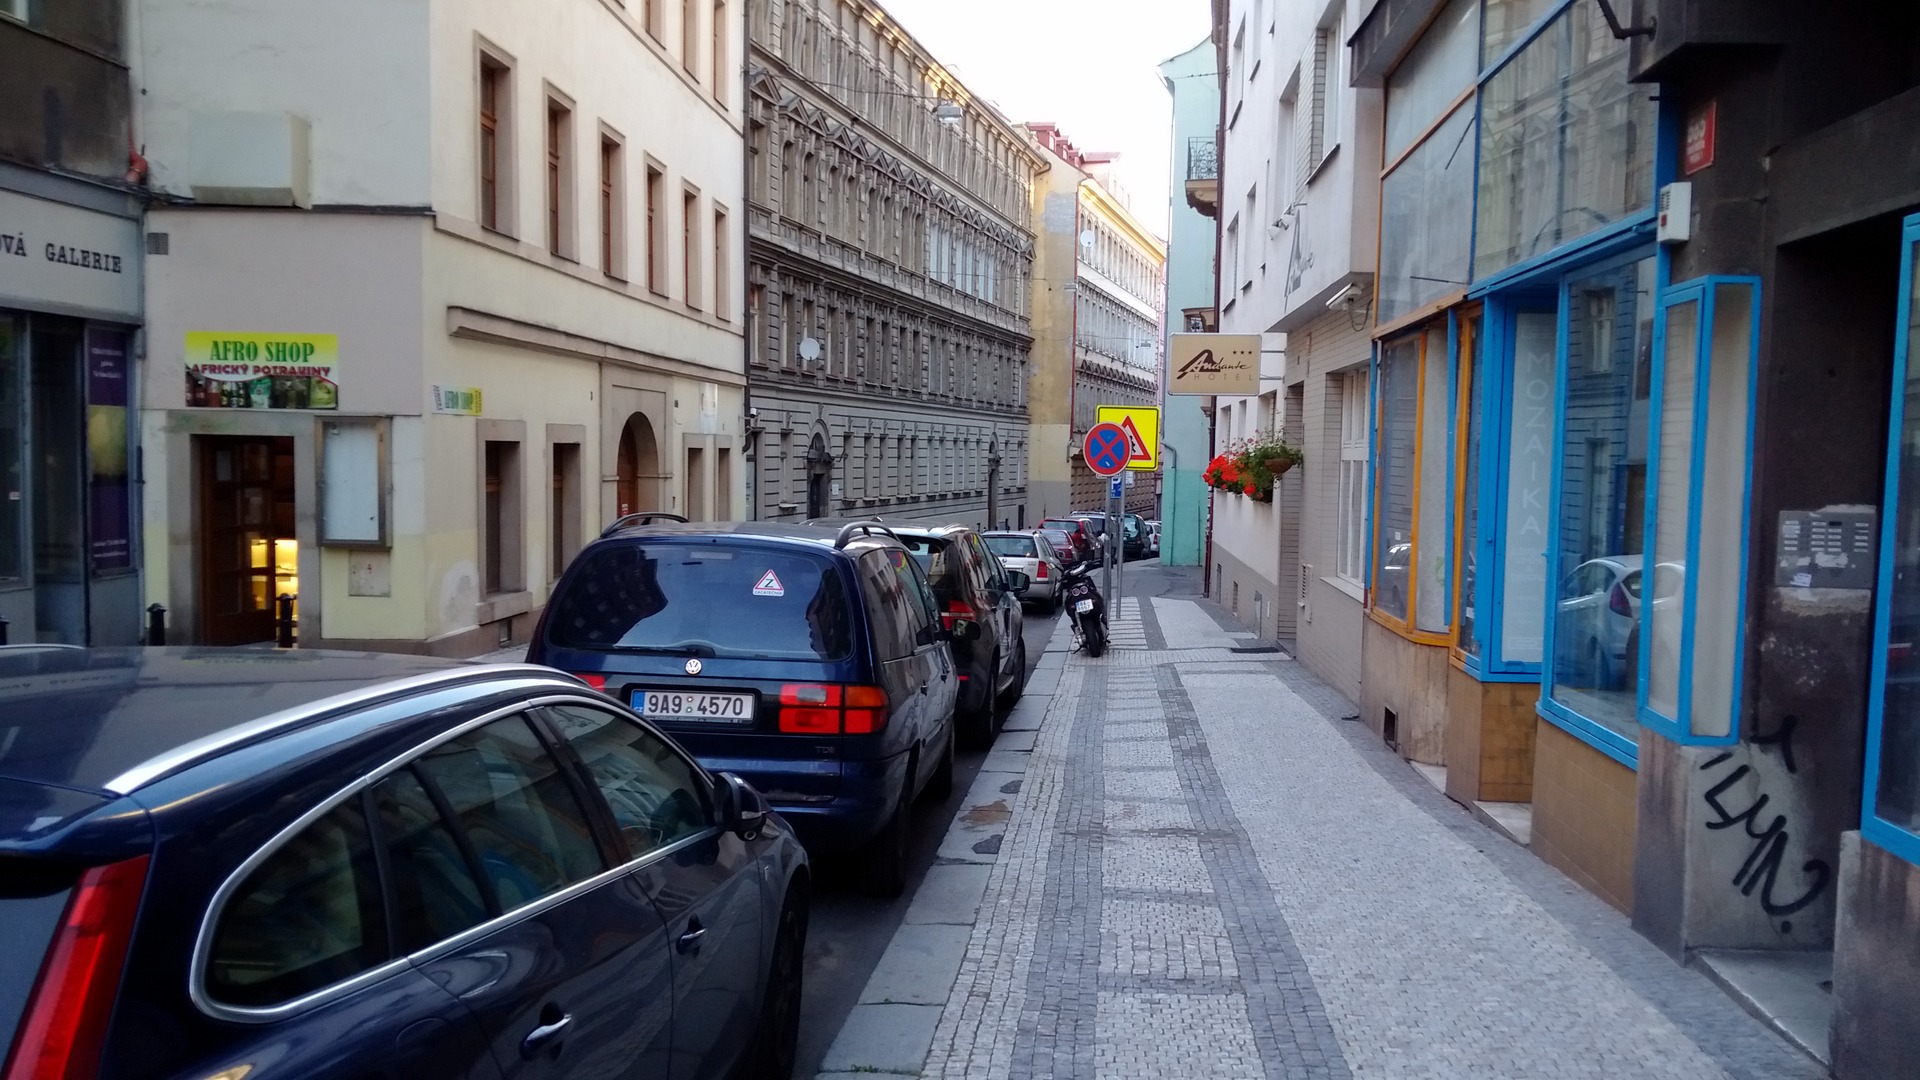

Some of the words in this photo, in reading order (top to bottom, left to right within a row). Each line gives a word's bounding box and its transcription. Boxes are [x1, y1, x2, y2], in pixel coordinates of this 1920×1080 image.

[0, 232, 27, 257] VÁ
[45, 242, 122, 274] GALERIE
[210, 340, 258, 362] AFRO
[265, 341, 315, 363] SHOP
[252, 365, 331, 377] POTRAVINY
[1176, 349, 1252, 380] Andante
[1194, 373, 1253, 381] HOTEL
[1520, 352, 1550, 536] MOZAIKA
[764, 578, 774, 588] Z
[648, 694, 682, 714] 9A9
[697, 696, 744, 716] 4570
